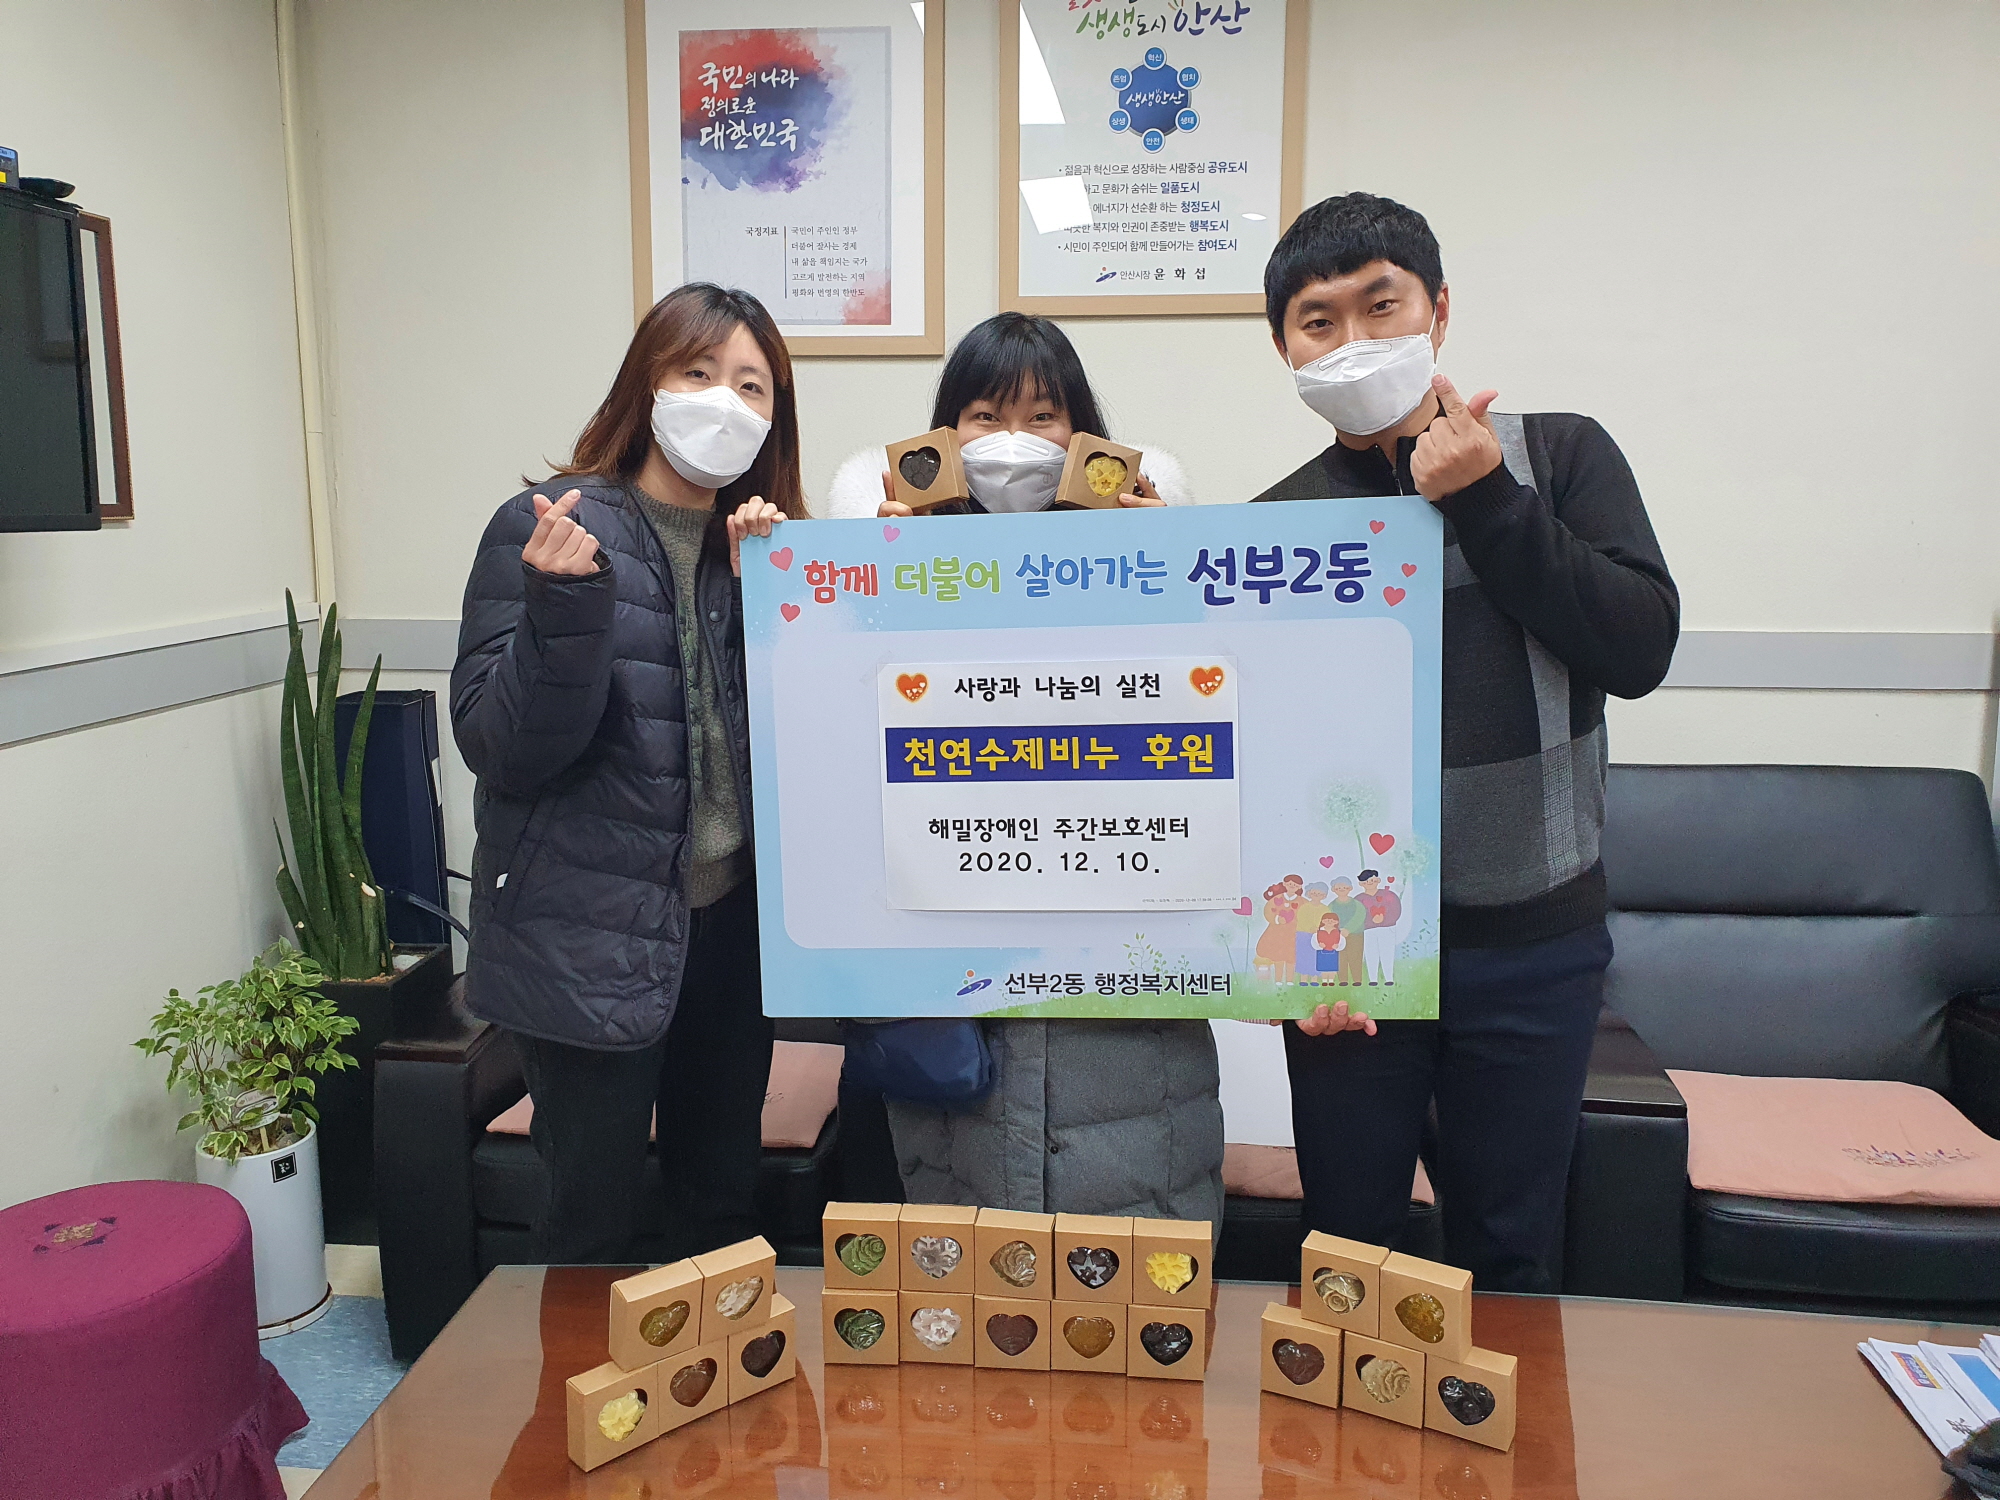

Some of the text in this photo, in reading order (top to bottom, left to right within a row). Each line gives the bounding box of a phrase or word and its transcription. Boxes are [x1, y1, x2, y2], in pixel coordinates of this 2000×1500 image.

[1173, 0, 1250, 36] 안산
[698, 62, 800, 94] 국민의 나라
[700, 96, 757, 118] 정의로운
[1126, 90, 1186, 108] 생생안산
[699, 118, 800, 152] 대한민국
[1064, 160, 1248, 176] 젊음과 혁신으로 성장하는 사람중심 공유도시
[1102, 183, 1129, 195] 문화가
[1131, 182, 1158, 194] 숨쉬는
[1160, 181, 1200, 194] 일품도시
[1093, 200, 1221, 214] 에너지가 선순환 하는 청정도시
[745, 226, 858, 236] 국정지표 국민이 주인인 정부
[1093, 221, 1119, 233] 복지와
[1121, 221, 1148, 233] 인권이
[1150, 220, 1186, 232] 존중받는
[1189, 219, 1230, 232] 행복도시
[842, 241, 857, 250] 경제
[1063, 239, 1238, 252] 시민이 주인되어 함께 만들어가는 참여도시
[852, 257, 868, 266] 국가
[850, 272, 865, 281] 지역
[1119, 270, 1150, 280] 안산시장
[842, 288, 865, 297] 한반도
[803, 541, 1373, 606] 함께 더불어 살아가는 선부2동
[954, 673, 1161, 702] 사랑과 나눔의 실천
[904, 733, 1214, 777] 천연수제비누 후원
[928, 817, 1190, 843] 해밀장애인 주간보호센터
[958, 852, 1160, 874] 2020. 12. 10.
[1004, 972, 1232, 996] 선부2동 행정복지센터
